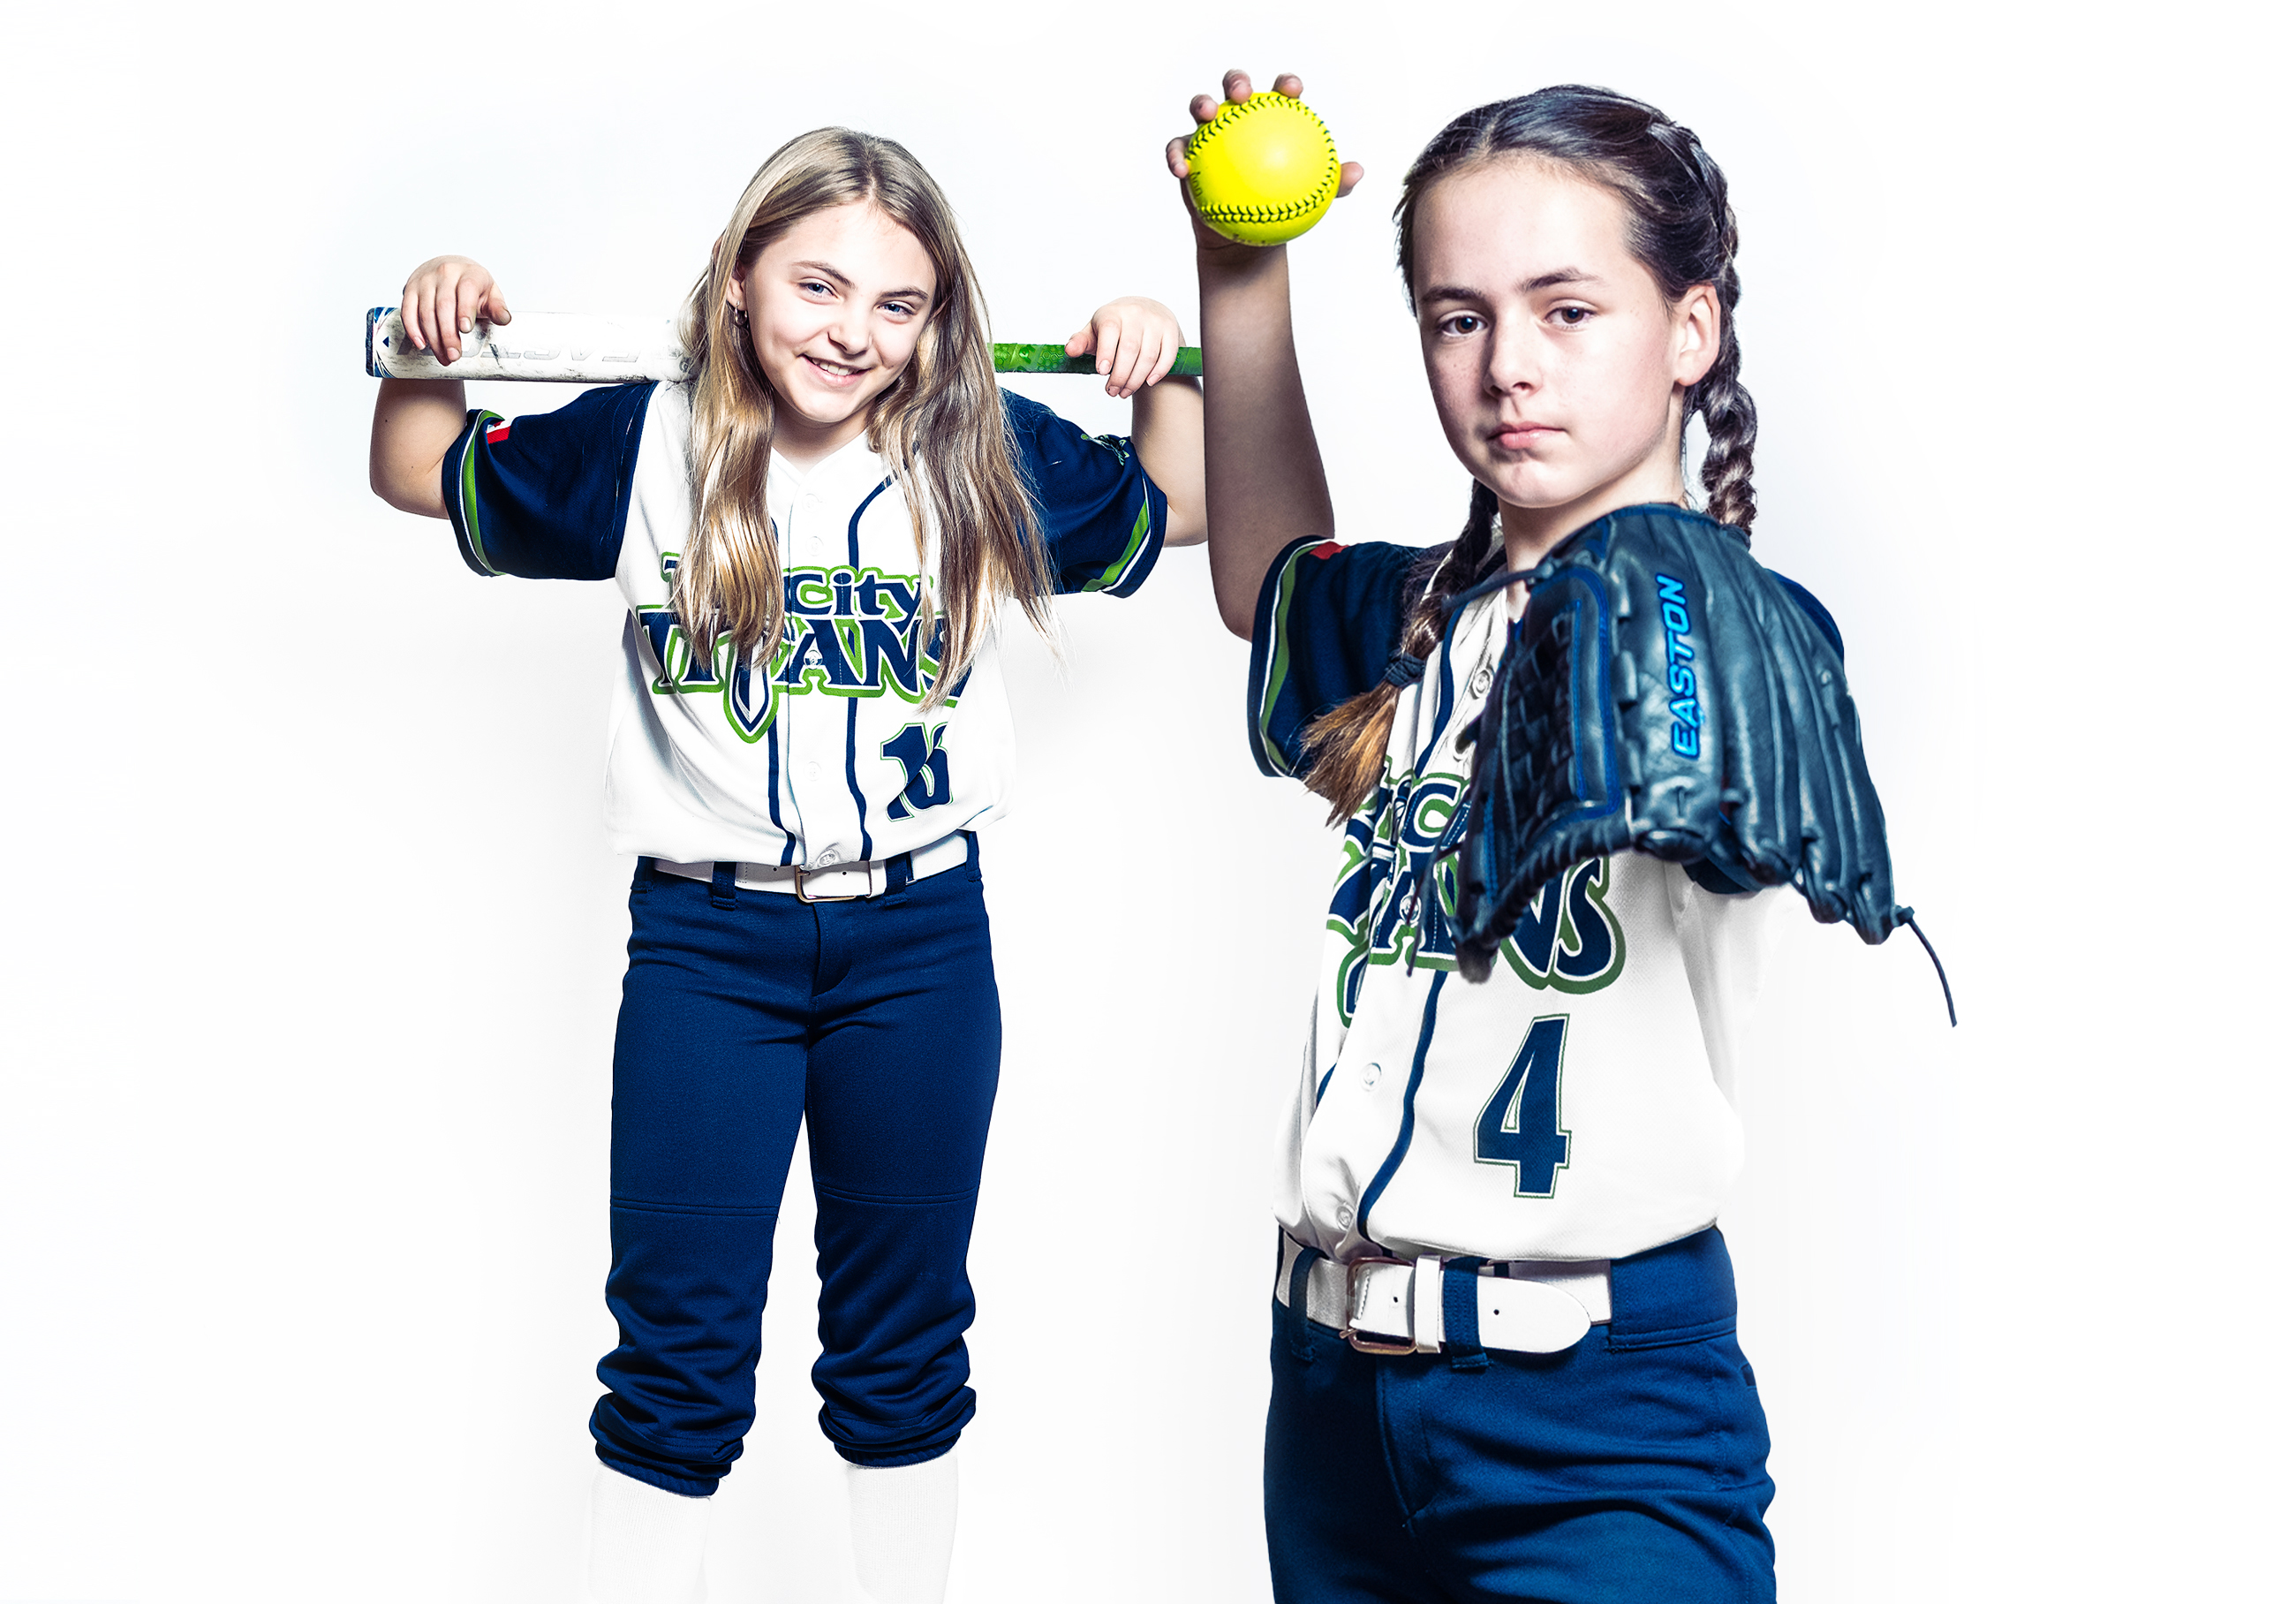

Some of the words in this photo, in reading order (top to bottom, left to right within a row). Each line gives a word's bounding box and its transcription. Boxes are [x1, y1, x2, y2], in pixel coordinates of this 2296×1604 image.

[783, 566, 931, 636] City
[1655, 573, 1701, 760] EASTON
[1474, 1013, 1572, 1199] 4
